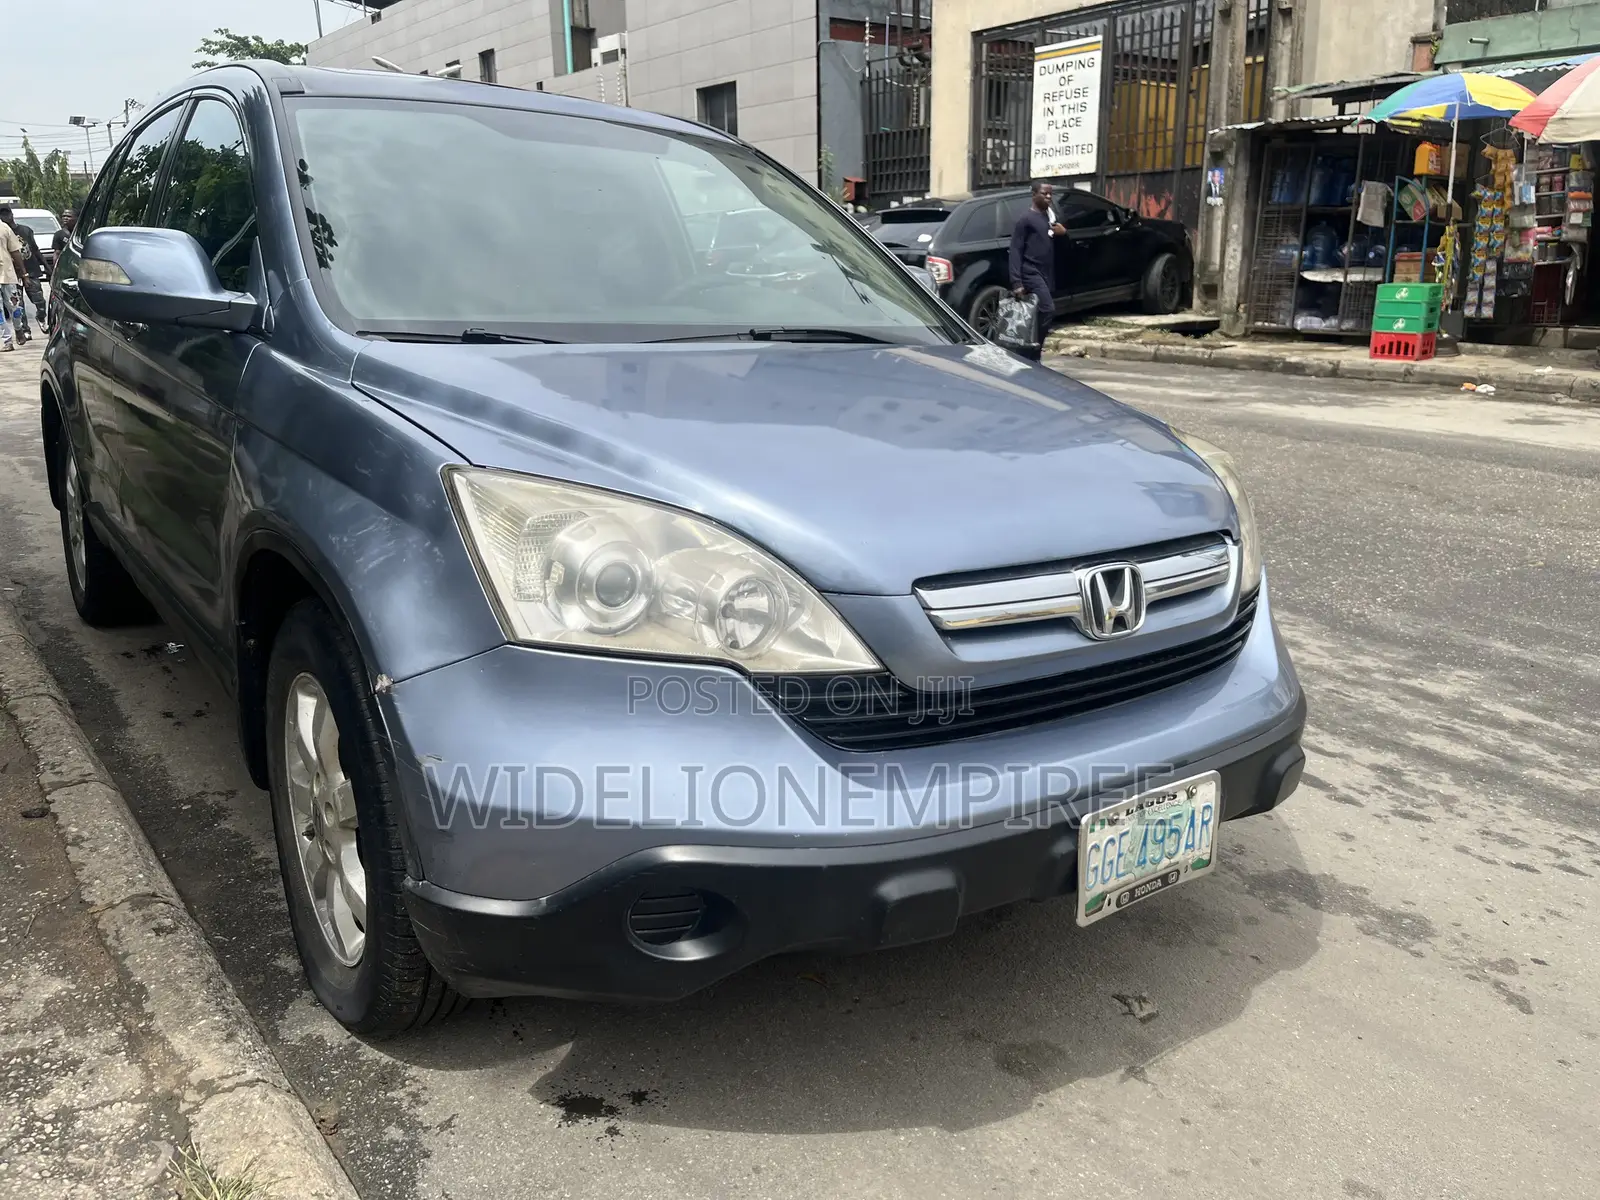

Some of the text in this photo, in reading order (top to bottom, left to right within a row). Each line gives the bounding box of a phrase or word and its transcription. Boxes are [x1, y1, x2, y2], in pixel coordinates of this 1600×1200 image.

[1039, 57, 1095, 76] DUMPING
[1058, 74, 1075, 87] OF
[1043, 87, 1089, 103] REFUSE
[1043, 101, 1088, 117] IN THIS
[1047, 117, 1082, 130] PLACE
[1058, 132, 1069, 143] IS
[1034, 143, 1094, 159] PROHIBITED
[1135, 878, 1162, 897] HONDA
